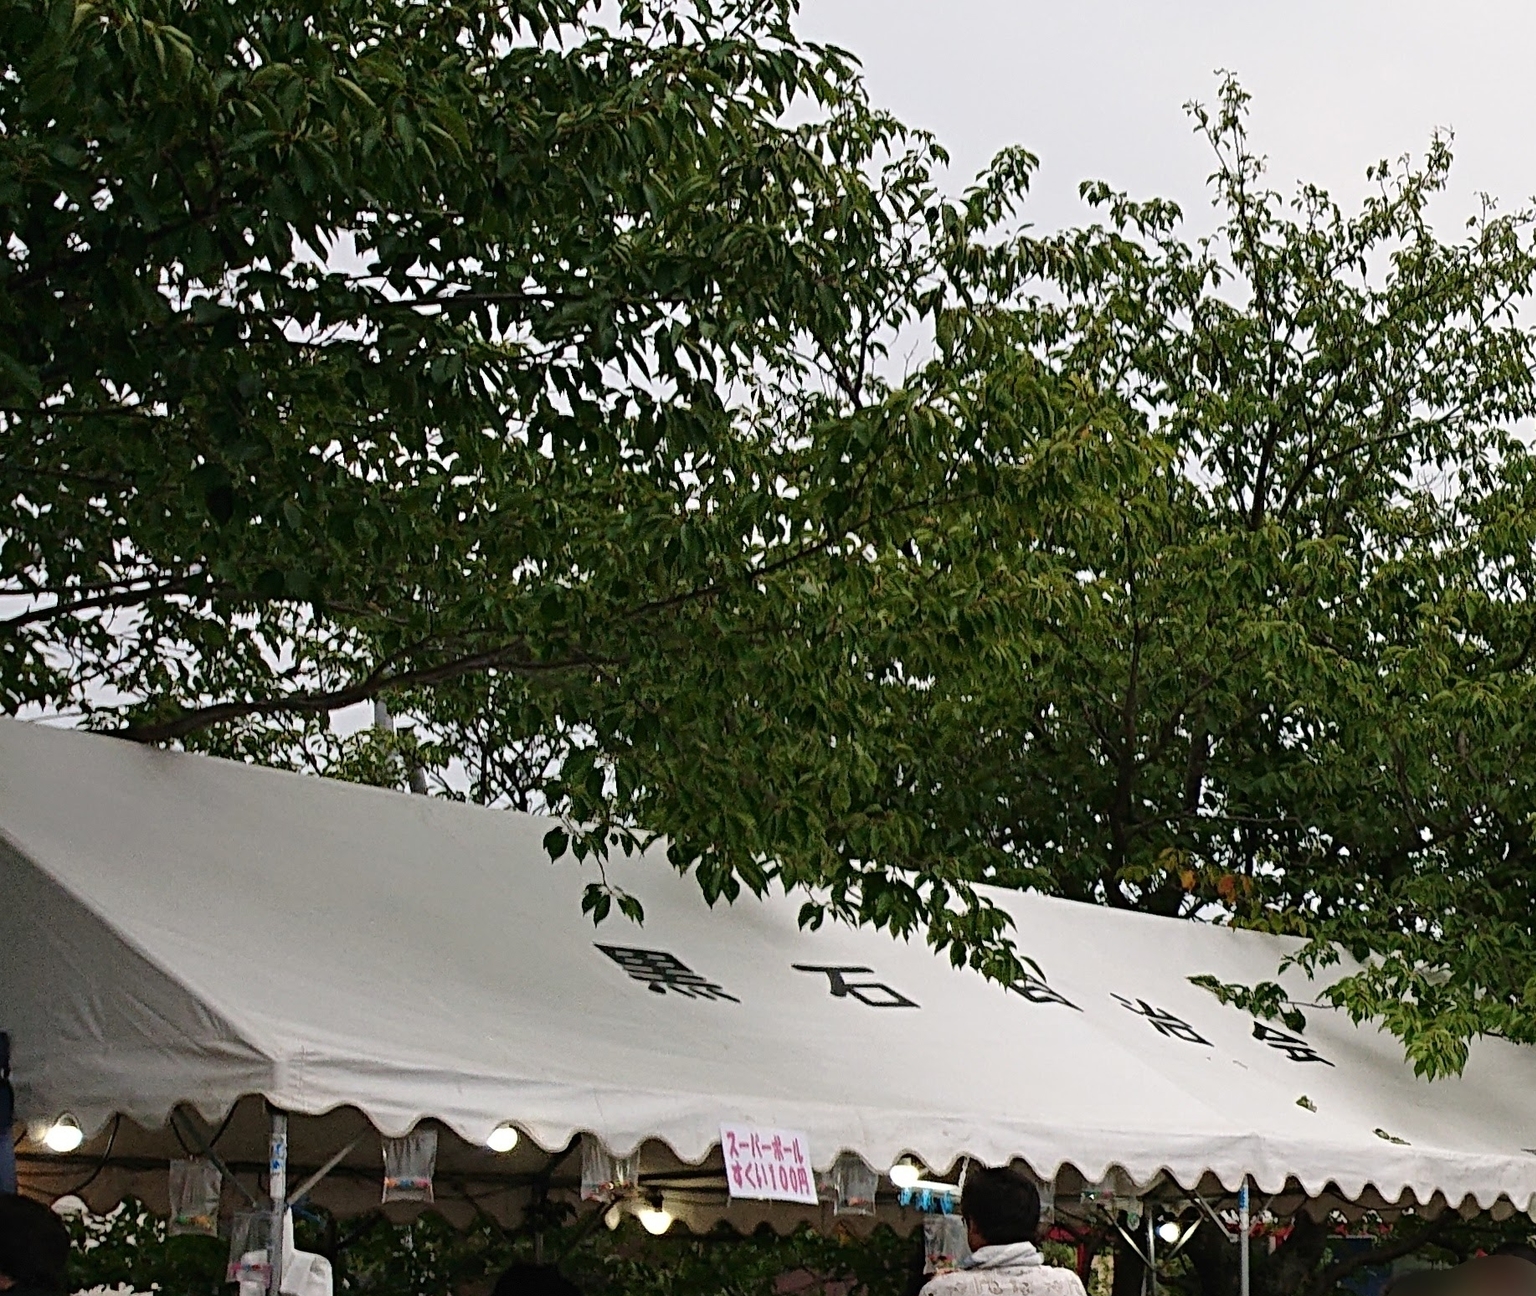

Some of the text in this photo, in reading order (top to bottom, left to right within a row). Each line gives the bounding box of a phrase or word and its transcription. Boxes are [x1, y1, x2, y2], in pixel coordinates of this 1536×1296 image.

[727, 1130, 803, 1164] スーパーボール
[731, 1160, 810, 1195] すくい100円
